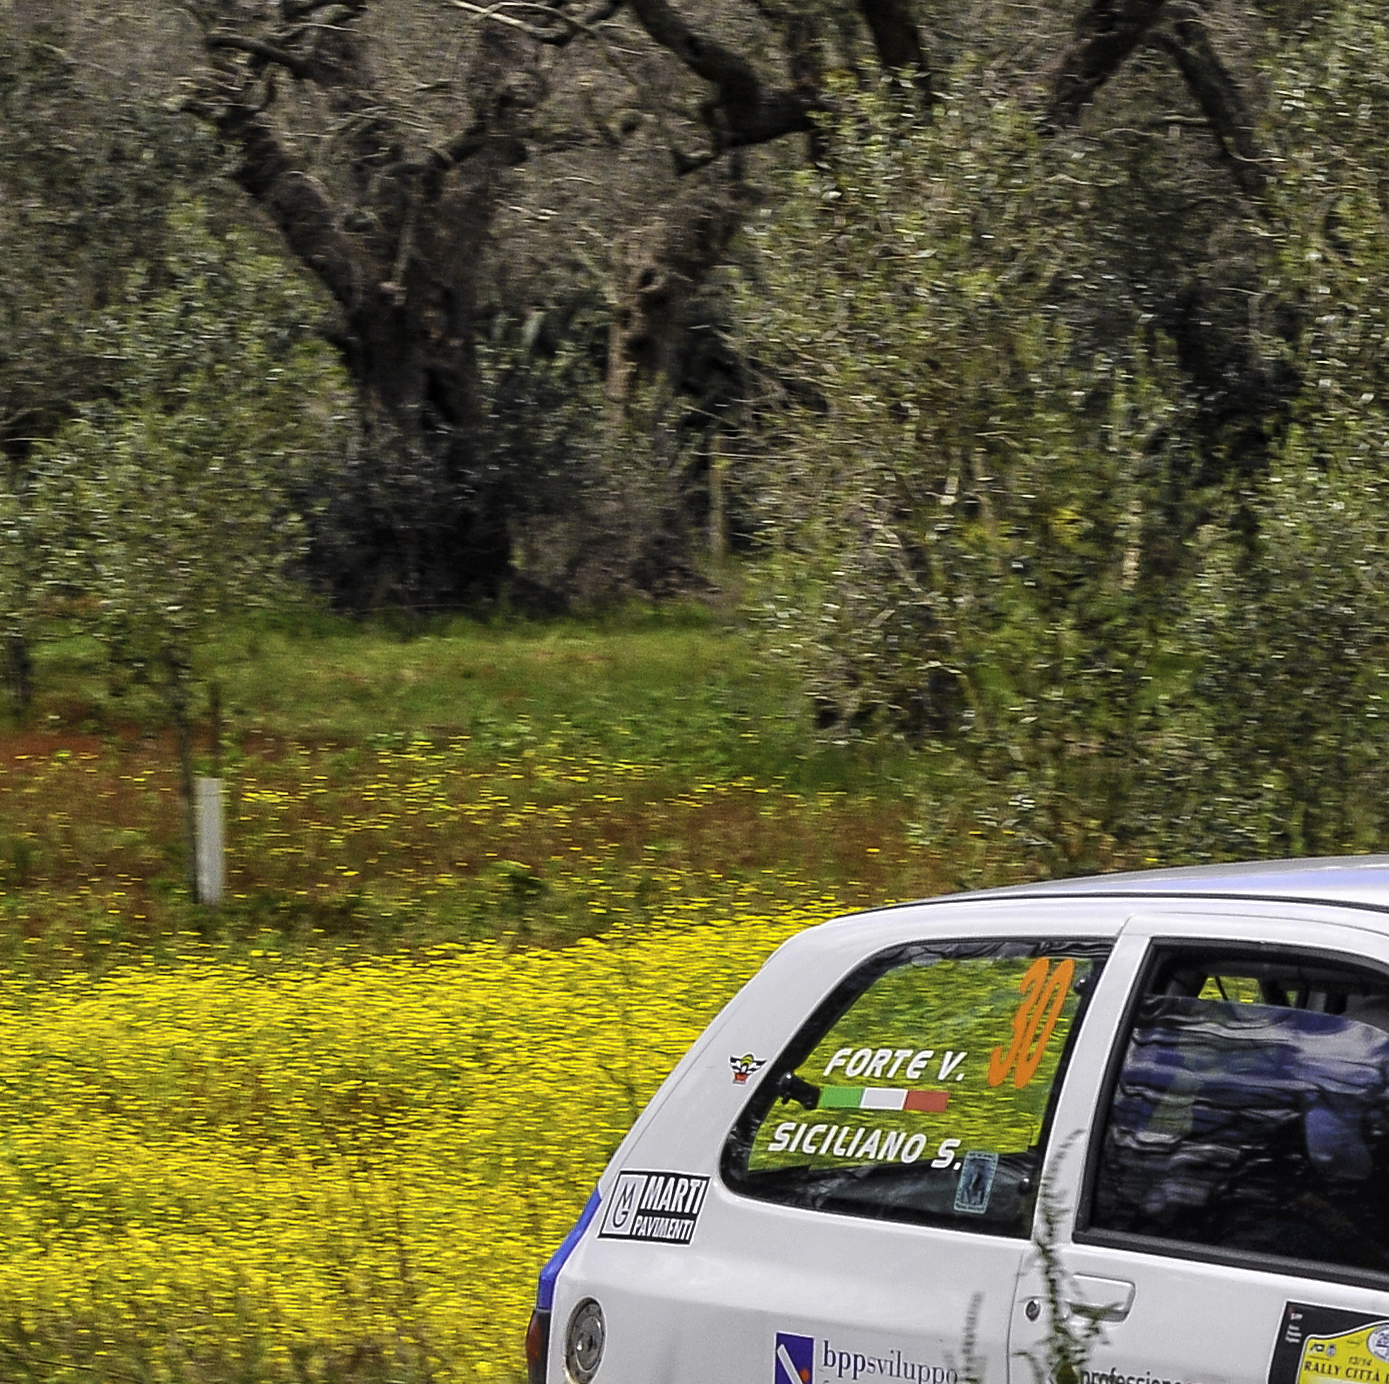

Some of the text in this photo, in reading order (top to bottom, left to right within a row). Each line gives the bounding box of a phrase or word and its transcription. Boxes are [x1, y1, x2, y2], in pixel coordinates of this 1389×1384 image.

[988, 957, 1075, 1089] 30
[823, 1047, 967, 1082] FORTE V.
[767, 1121, 962, 1171] SICILIANO S.
[640, 1175, 708, 1214] MARTI
[632, 1215, 695, 1241] PAVIMENTI
[1303, 1360, 1340, 1376] RALLY
